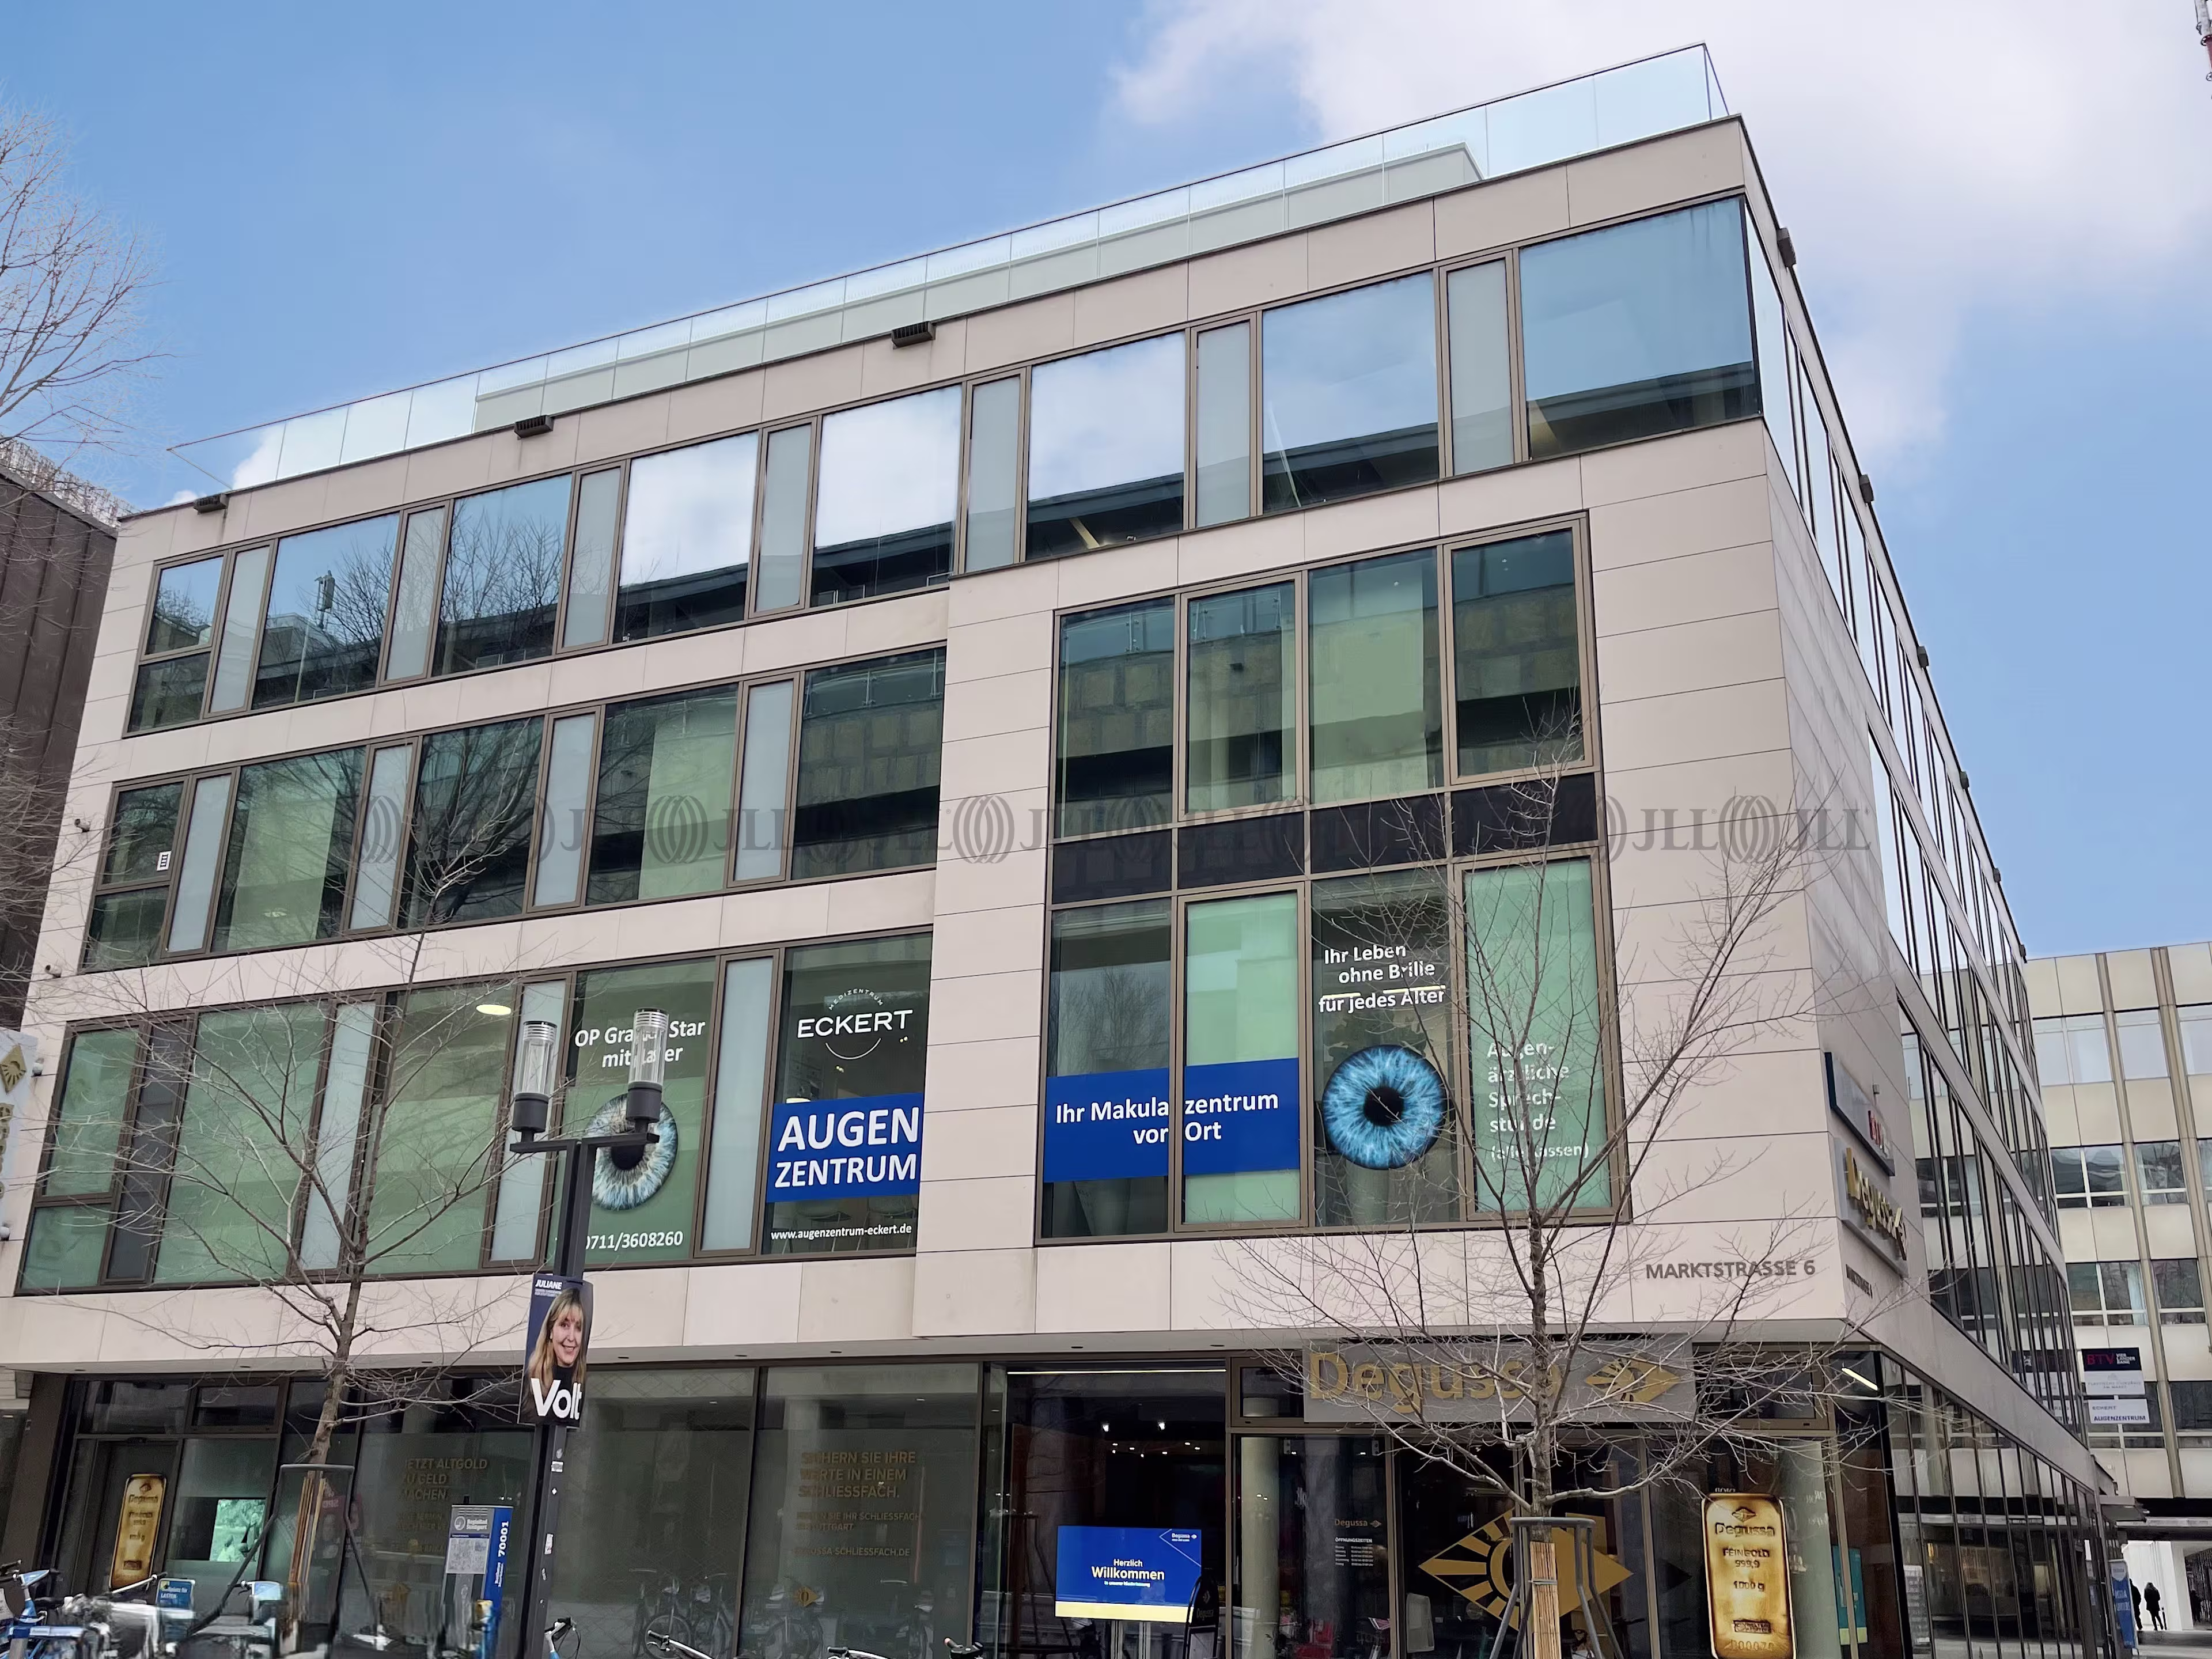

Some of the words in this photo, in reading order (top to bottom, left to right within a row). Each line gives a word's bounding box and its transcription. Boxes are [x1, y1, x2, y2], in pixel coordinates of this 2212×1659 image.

[1325, 948, 1349, 964] Ihr
[1354, 944, 1406, 961] Leben
[1338, 966, 1384, 984] ohne
[1389, 960, 1435, 980] Brille
[828, 988, 884, 1011] MEDIZENTRUM
[1318, 995, 1345, 1013] für
[1347, 992, 1396, 1014] jedes
[1400, 987, 1445, 1006] Alter
[574, 1028, 601, 1047] OP
[669, 1020, 706, 1038] Star
[797, 1009, 914, 1039] ECKERT
[602, 1048, 632, 1068] mit
[1488, 1063, 1570, 1083] ärzliche
[1056, 1103, 1085, 1124] Ihr
[777, 1107, 919, 1152] AUGEN
[1133, 1127, 1169, 1145] vor
[1184, 1120, 1222, 1142] Ort
[774, 1153, 917, 1188] ZENTRUM
[770, 1222, 912, 1241] www.augenzentrum-eckert.de
[1646, 1260, 1797, 1279] MARKTSTRASSE
[1804, 1259, 1816, 1275] 6
[535, 1279, 563, 1290] JULIANE
[2088, 1353, 2115, 1365] BTV
[1310, 1353, 1563, 1414] Deguss
[530, 1377, 582, 1421] Volt
[861, 1452, 882, 1464] SIE
[885, 1451, 916, 1464] IHRE
[865, 1469, 907, 1480] EINEM
[1334, 1518, 1368, 1528] Degussa
[1714, 1522, 1775, 1537] Degussa
[498, 1521, 509, 1558] 70001
[1113, 1558, 1143, 1567] Herzlich
[1091, 1566, 1165, 1581] Willkommen
